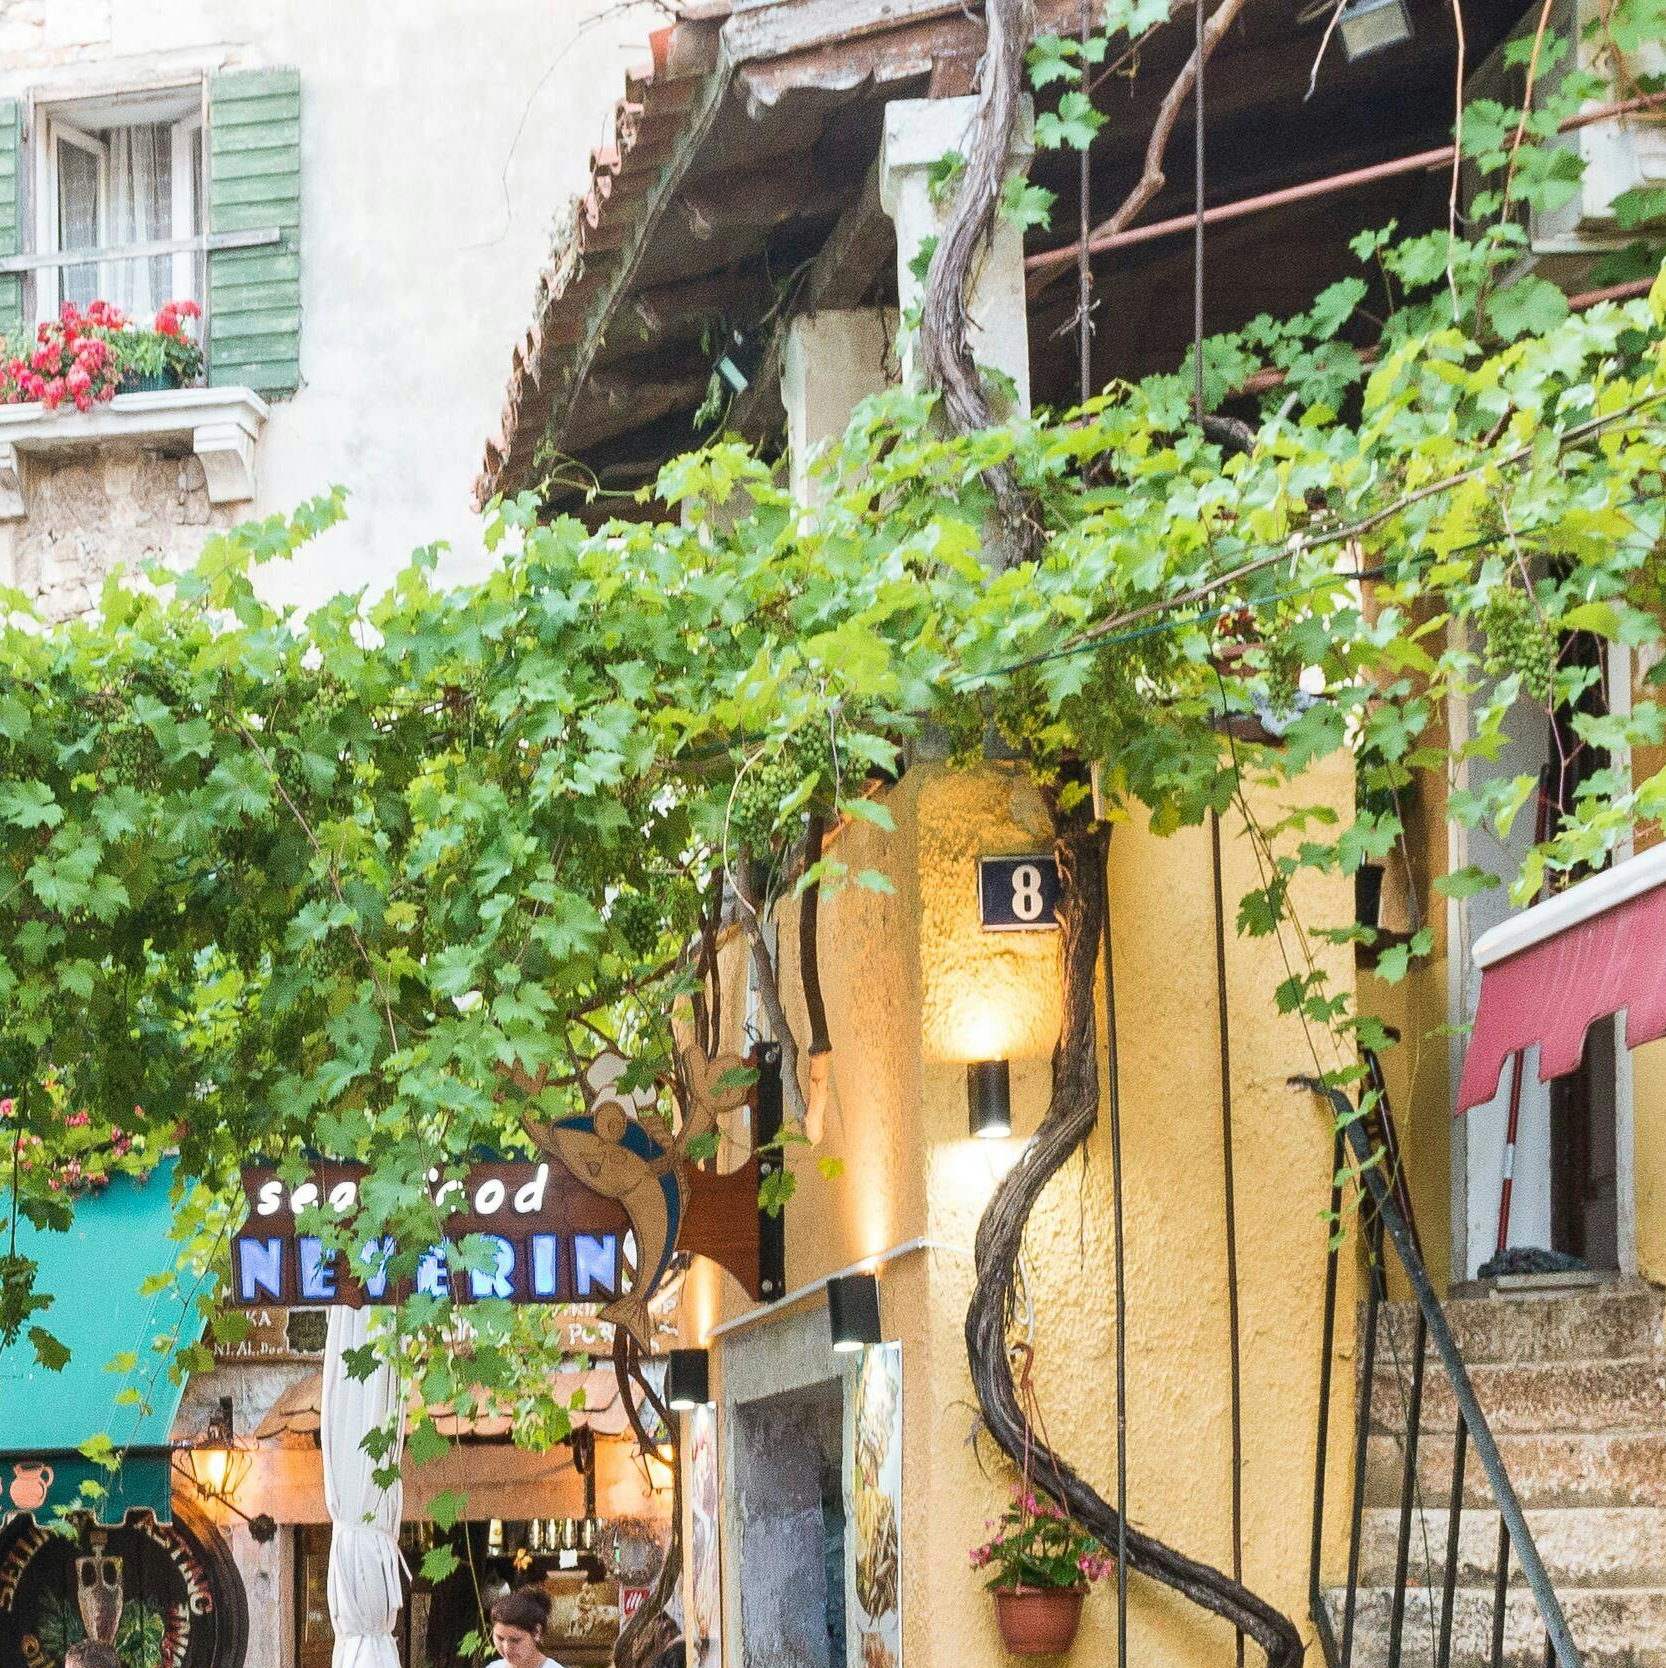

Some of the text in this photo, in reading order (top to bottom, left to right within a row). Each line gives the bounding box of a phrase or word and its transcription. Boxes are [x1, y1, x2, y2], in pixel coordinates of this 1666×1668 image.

[1012, 864, 1044, 921] 8
[238, 1233, 618, 1300] NEVERIN
[133, 1511, 214, 1616] ASTING
